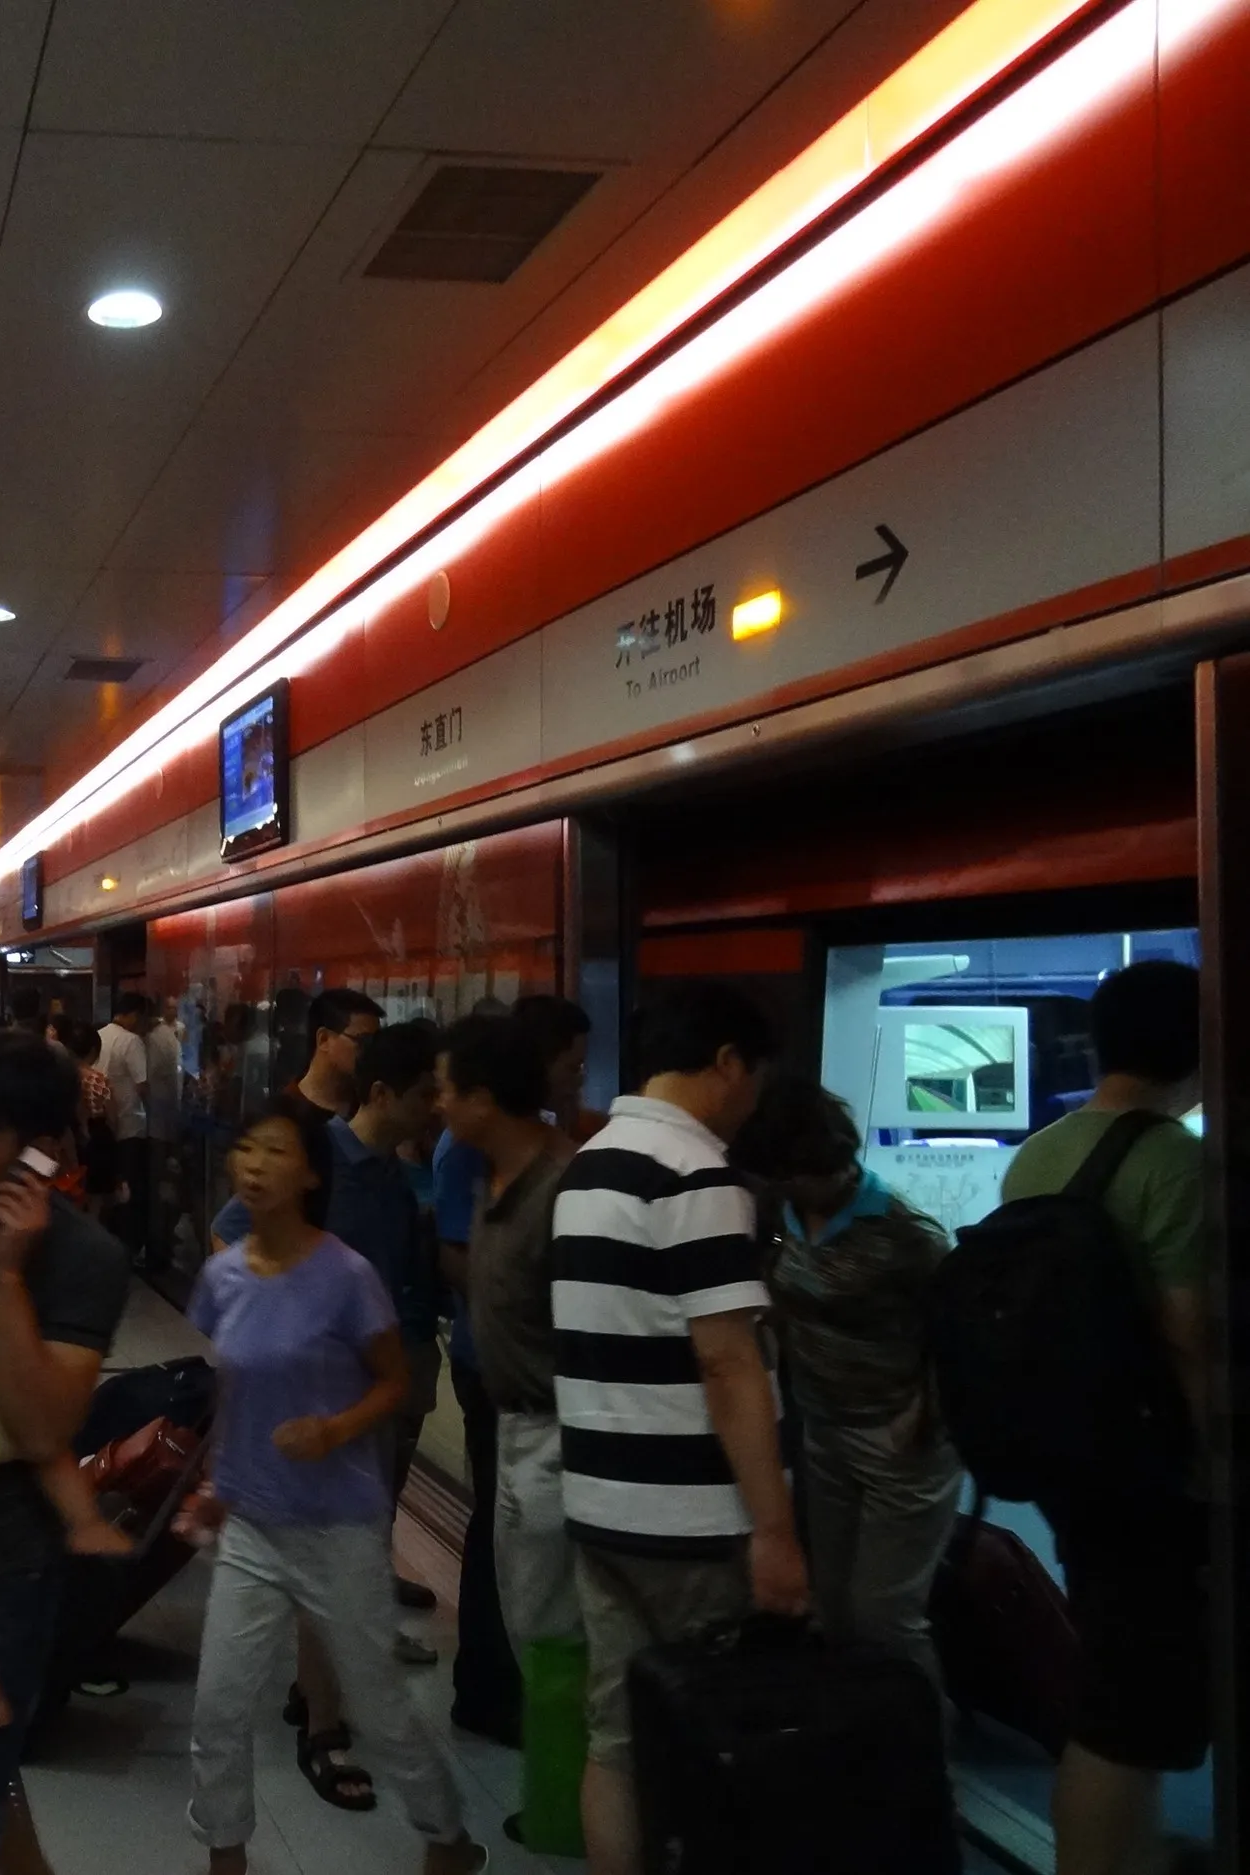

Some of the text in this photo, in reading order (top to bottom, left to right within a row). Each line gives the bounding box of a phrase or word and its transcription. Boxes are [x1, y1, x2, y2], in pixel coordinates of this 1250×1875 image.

[626, 656, 700, 697] To Airport
[419, 706, 462, 756] 东直门
